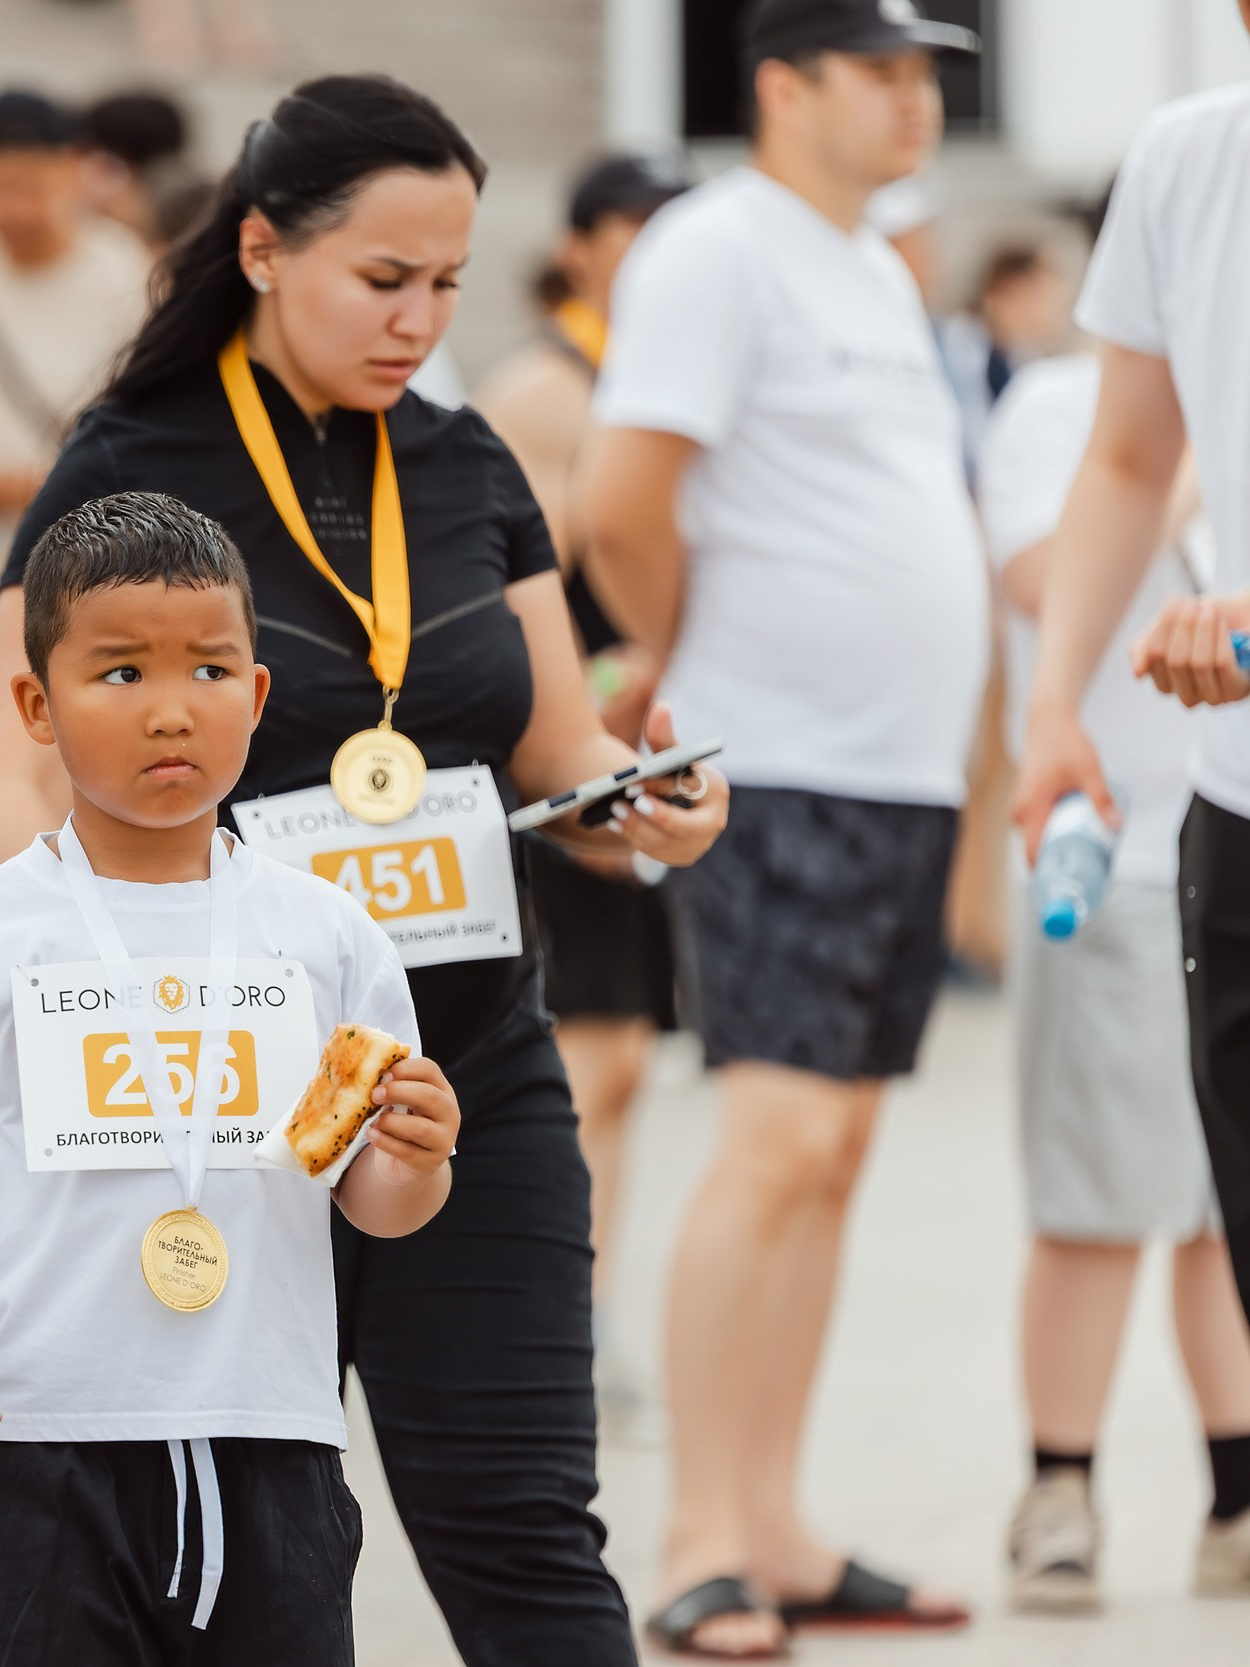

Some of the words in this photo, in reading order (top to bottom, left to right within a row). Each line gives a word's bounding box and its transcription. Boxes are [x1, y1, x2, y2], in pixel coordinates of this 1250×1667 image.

[264, 807, 358, 840] LEONE
[404, 790, 478, 821] ORO
[333, 844, 446, 913] 451
[41, 986, 144, 1014] LEONE
[102, 1042, 241, 1105] 256
[158, 1240, 218, 1266] ТВОРИТЕЛЬНЫЙ
[174, 1236, 204, 1251] БЛАГО-
[172, 1267, 197, 1279] Finisher
[174, 1256, 198, 1269] ЗАБЕГ
[159, 1272, 181, 1285] LEONE
